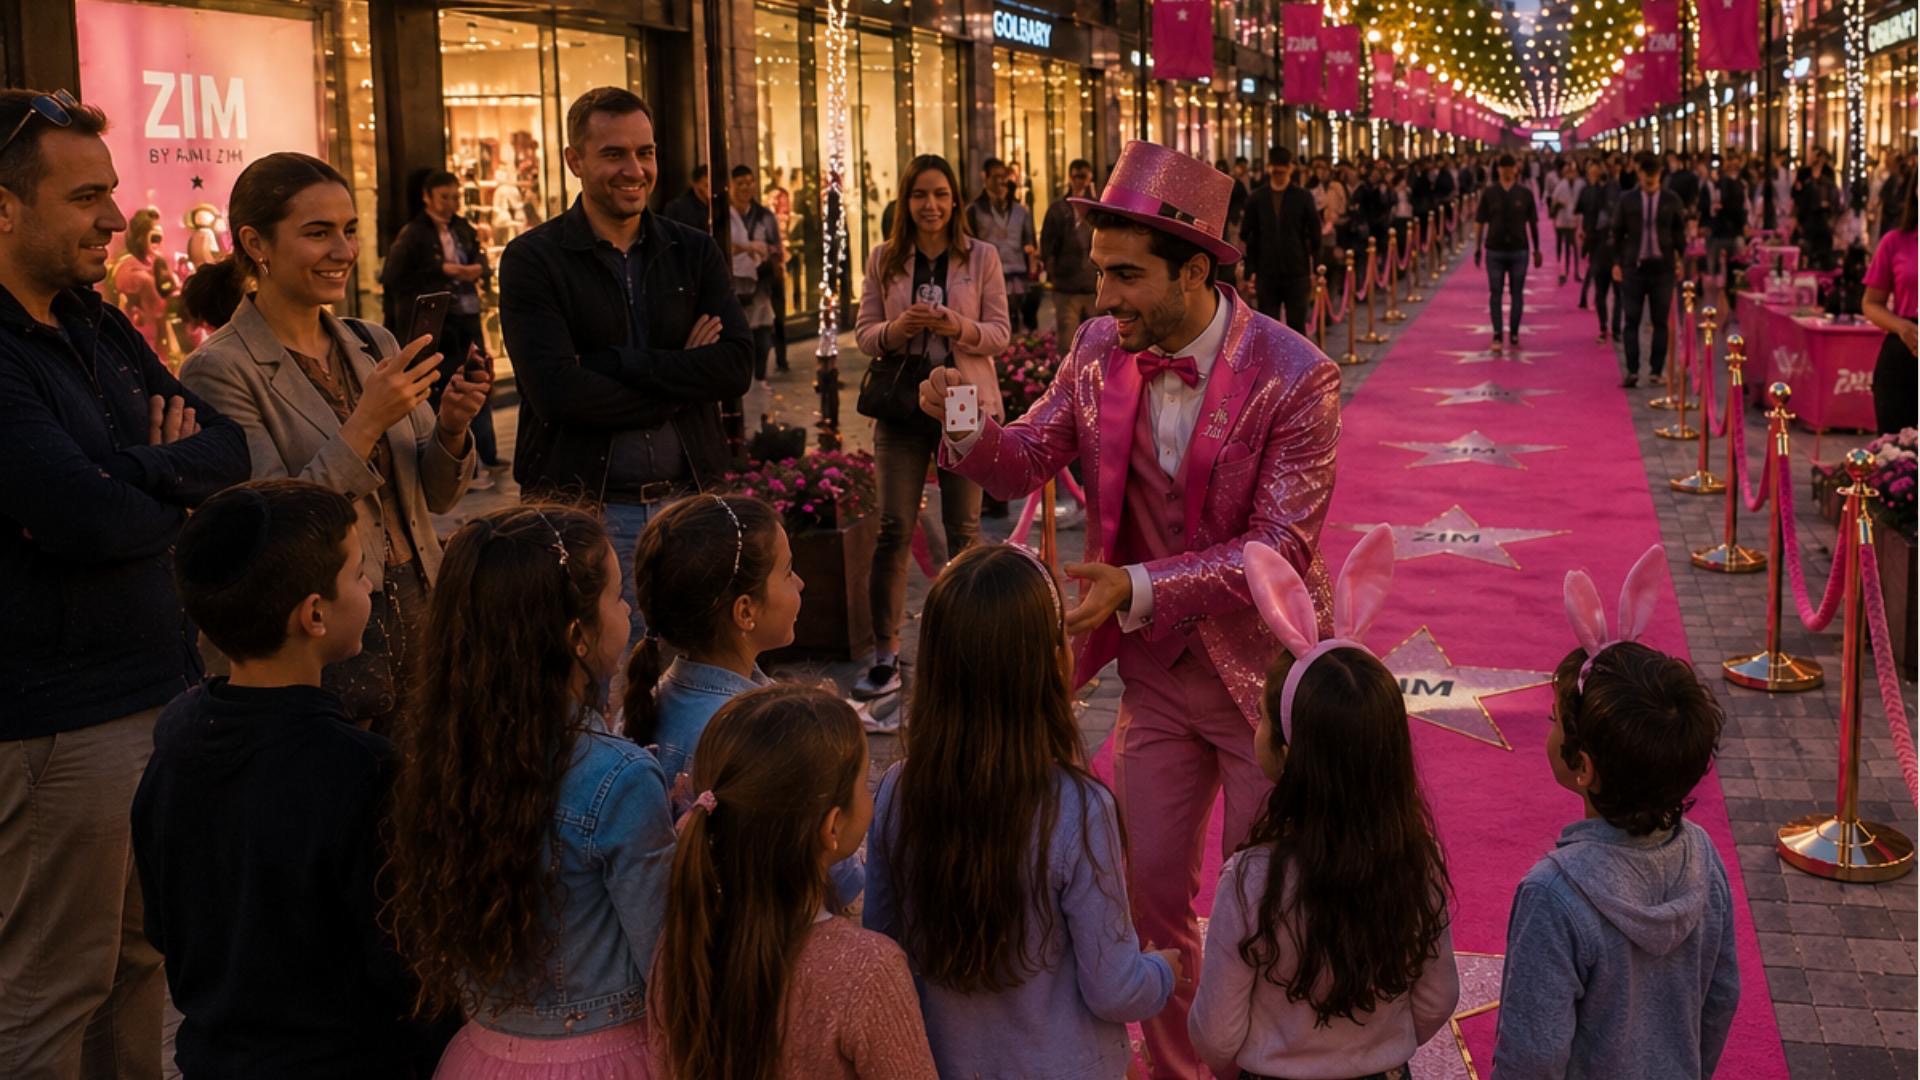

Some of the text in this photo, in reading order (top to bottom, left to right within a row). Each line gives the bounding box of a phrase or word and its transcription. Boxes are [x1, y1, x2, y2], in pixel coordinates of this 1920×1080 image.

[143, 70, 248, 138] ZIM
[149, 148, 169, 164] BY
[1412, 531, 1480, 544] ZIM
[1399, 677, 1455, 697] IM
